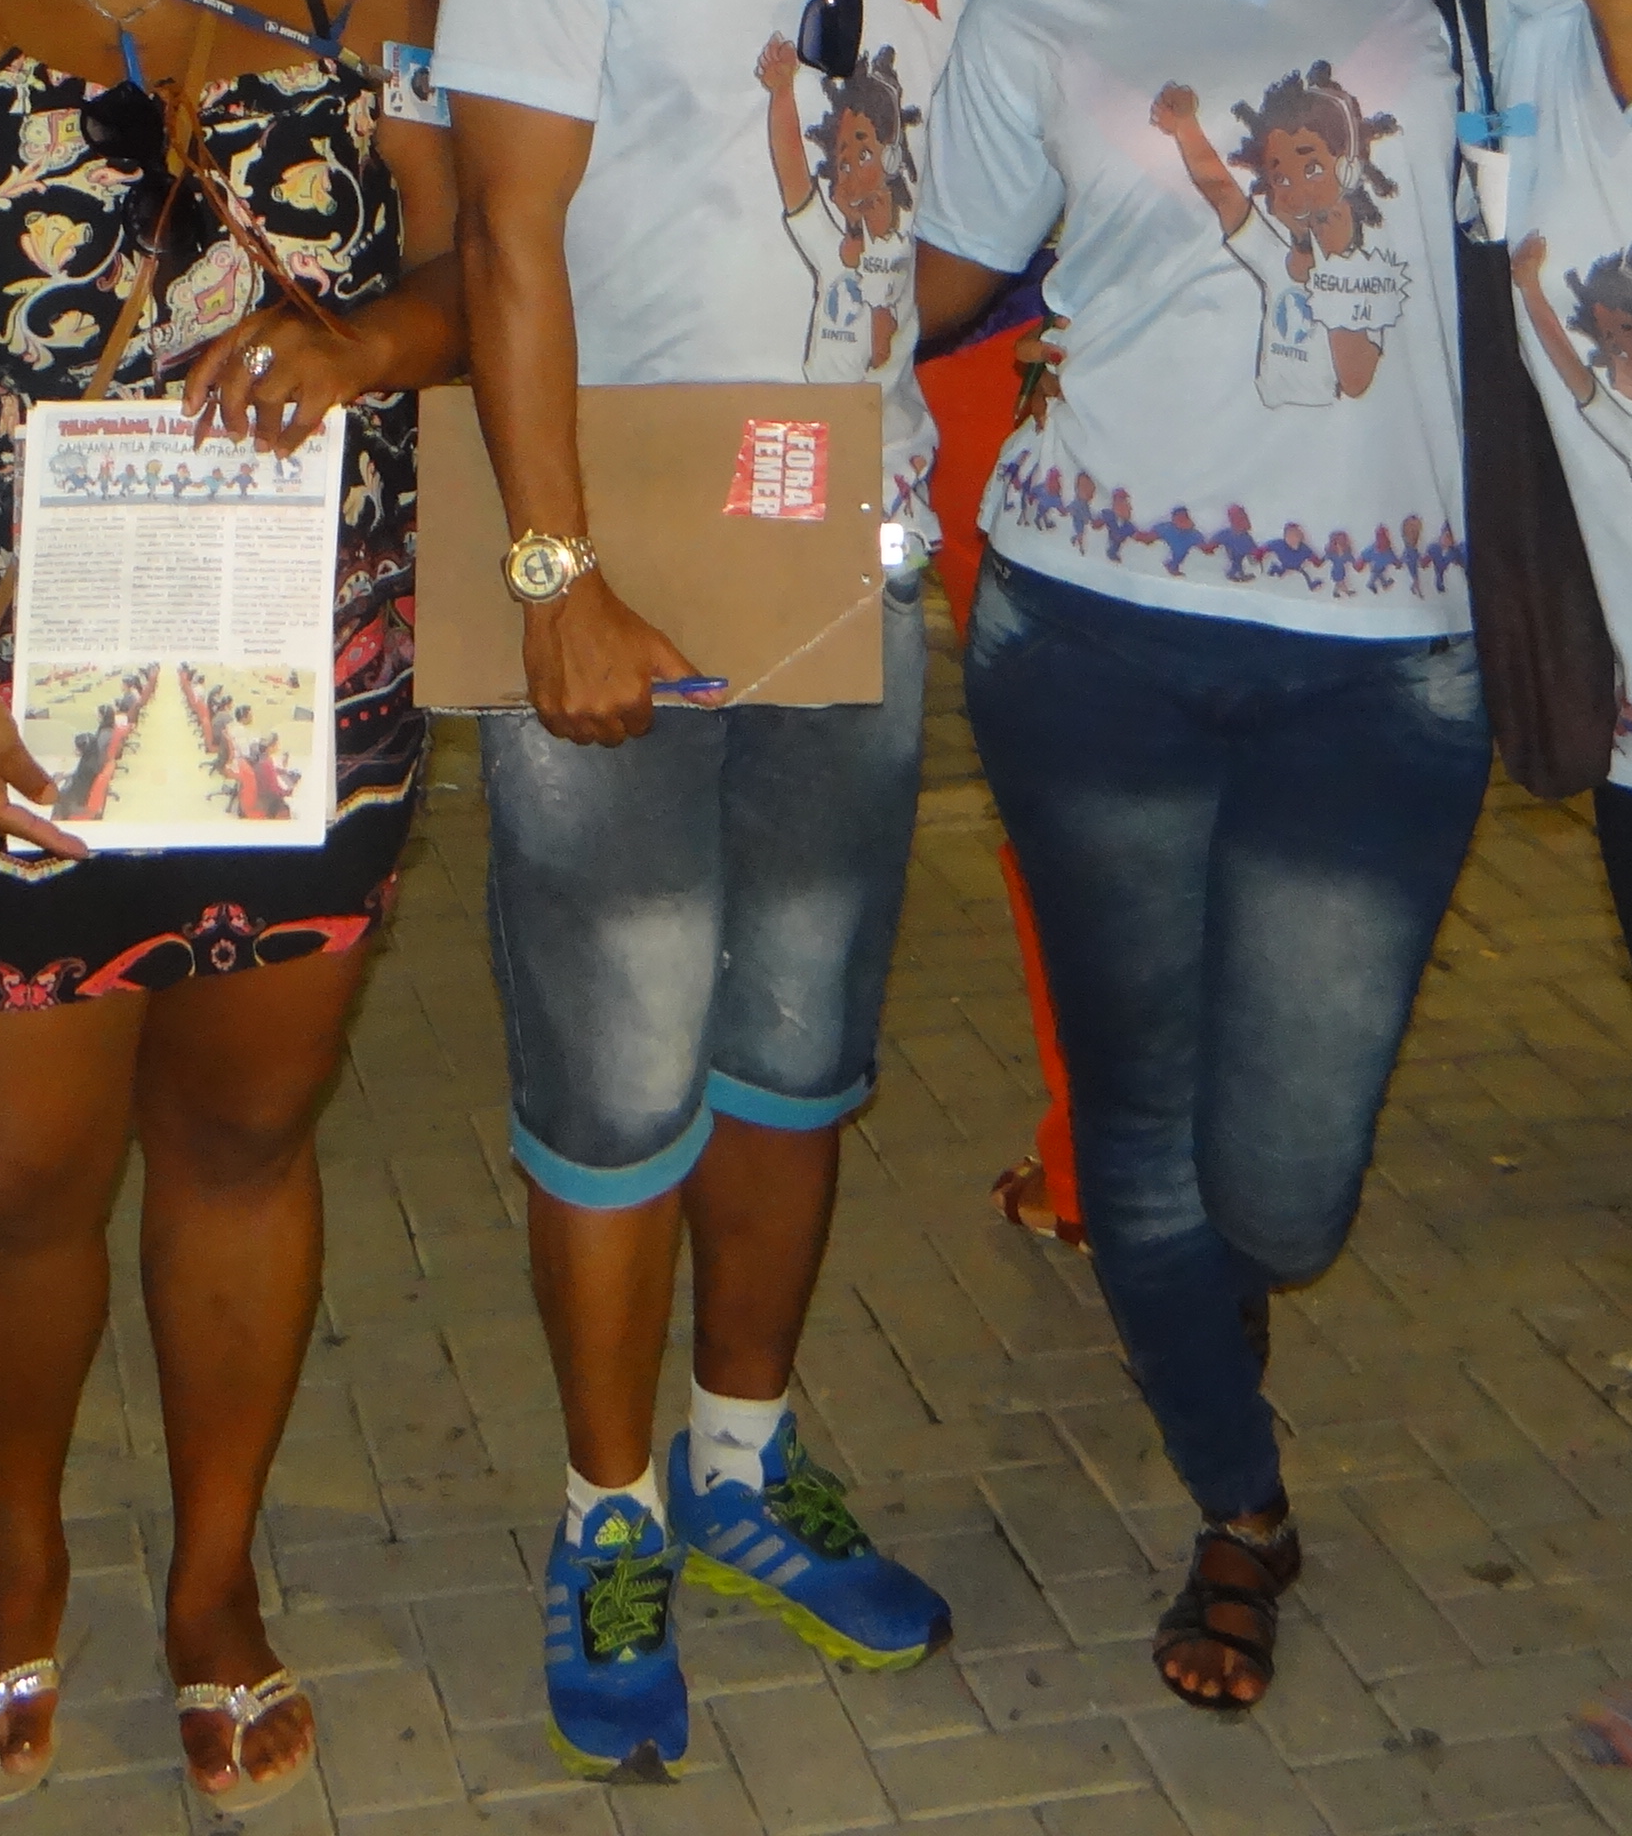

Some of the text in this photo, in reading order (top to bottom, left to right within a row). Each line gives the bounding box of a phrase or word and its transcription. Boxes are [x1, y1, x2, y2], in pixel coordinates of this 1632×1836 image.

[1313, 272, 1399, 295] REGULAMENTA
[751, 426, 784, 515] TEMER
[784, 431, 815, 506] FORA
